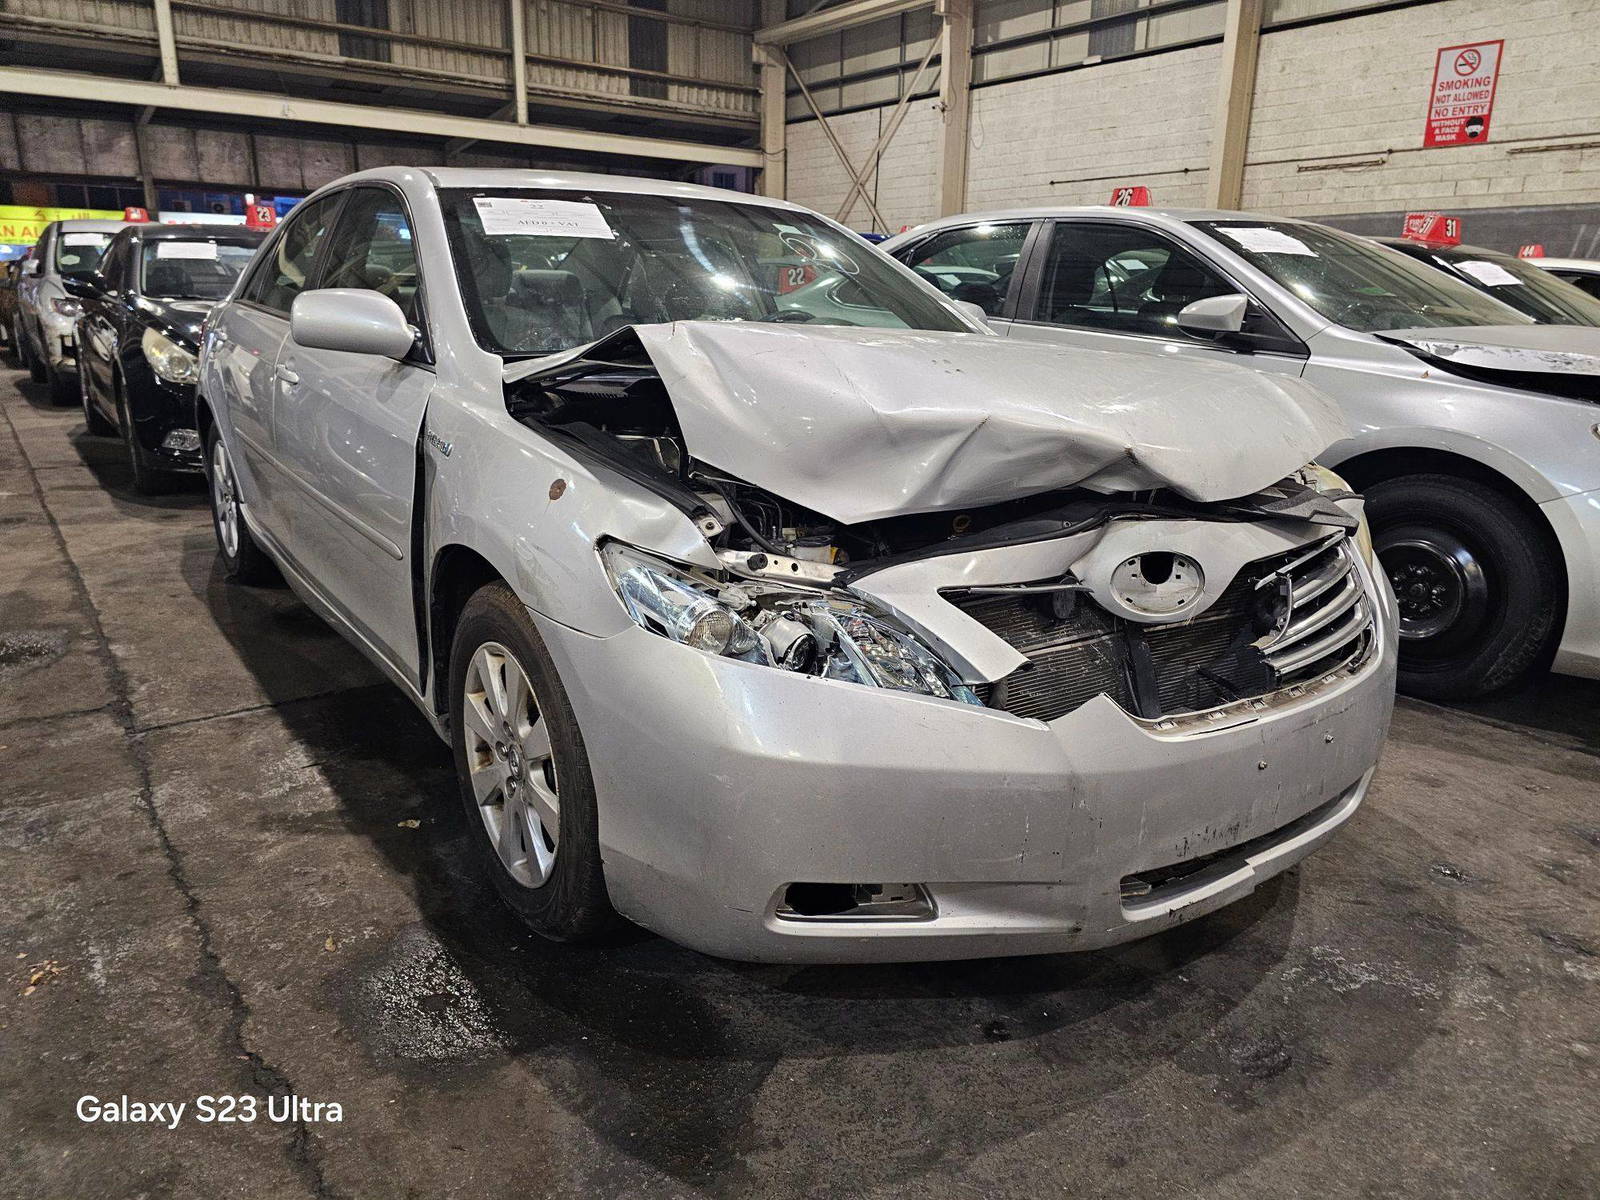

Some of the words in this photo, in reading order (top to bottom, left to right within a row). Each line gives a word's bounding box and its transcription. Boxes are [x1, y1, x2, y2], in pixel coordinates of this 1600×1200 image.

[1438, 76, 1491, 92] SMOKING
[1434, 94, 1451, 104] NOT
[1452, 90, 1490, 102] ALLOWED
[1434, 108, 1449, 118] NO
[1451, 104, 1487, 115] ENTRY
[1431, 118, 1466, 128] WITHOUT
[1114, 188, 1133, 208] 26
[256, 207, 271, 222] 23
[1445, 218, 1457, 238] 31
[788, 268, 805, 286] 22
